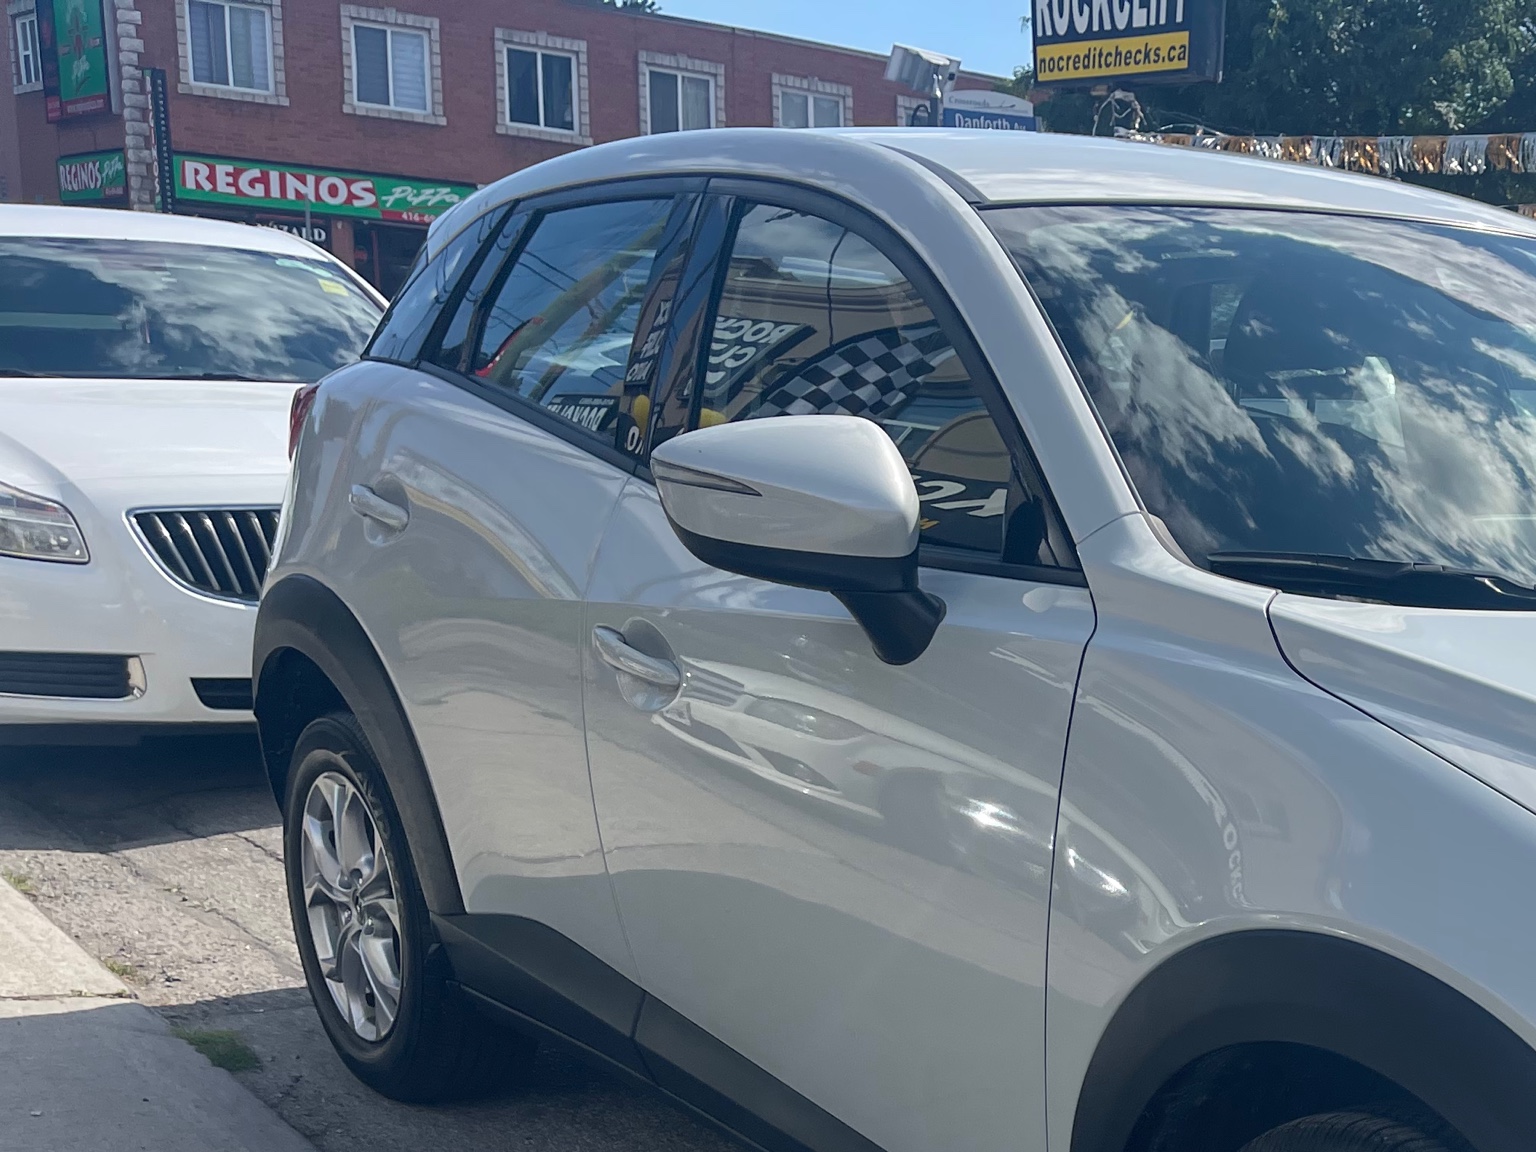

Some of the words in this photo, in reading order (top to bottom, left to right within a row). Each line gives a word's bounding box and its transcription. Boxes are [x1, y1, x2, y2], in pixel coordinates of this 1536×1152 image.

[1038, 43, 1187, 74] nocreditchecks.ca
[955, 113, 1010, 130] Danforth
[59, 160, 102, 192] REGINOS
[184, 160, 376, 207] REGINOS
[381, 185, 461, 208] Pizza
